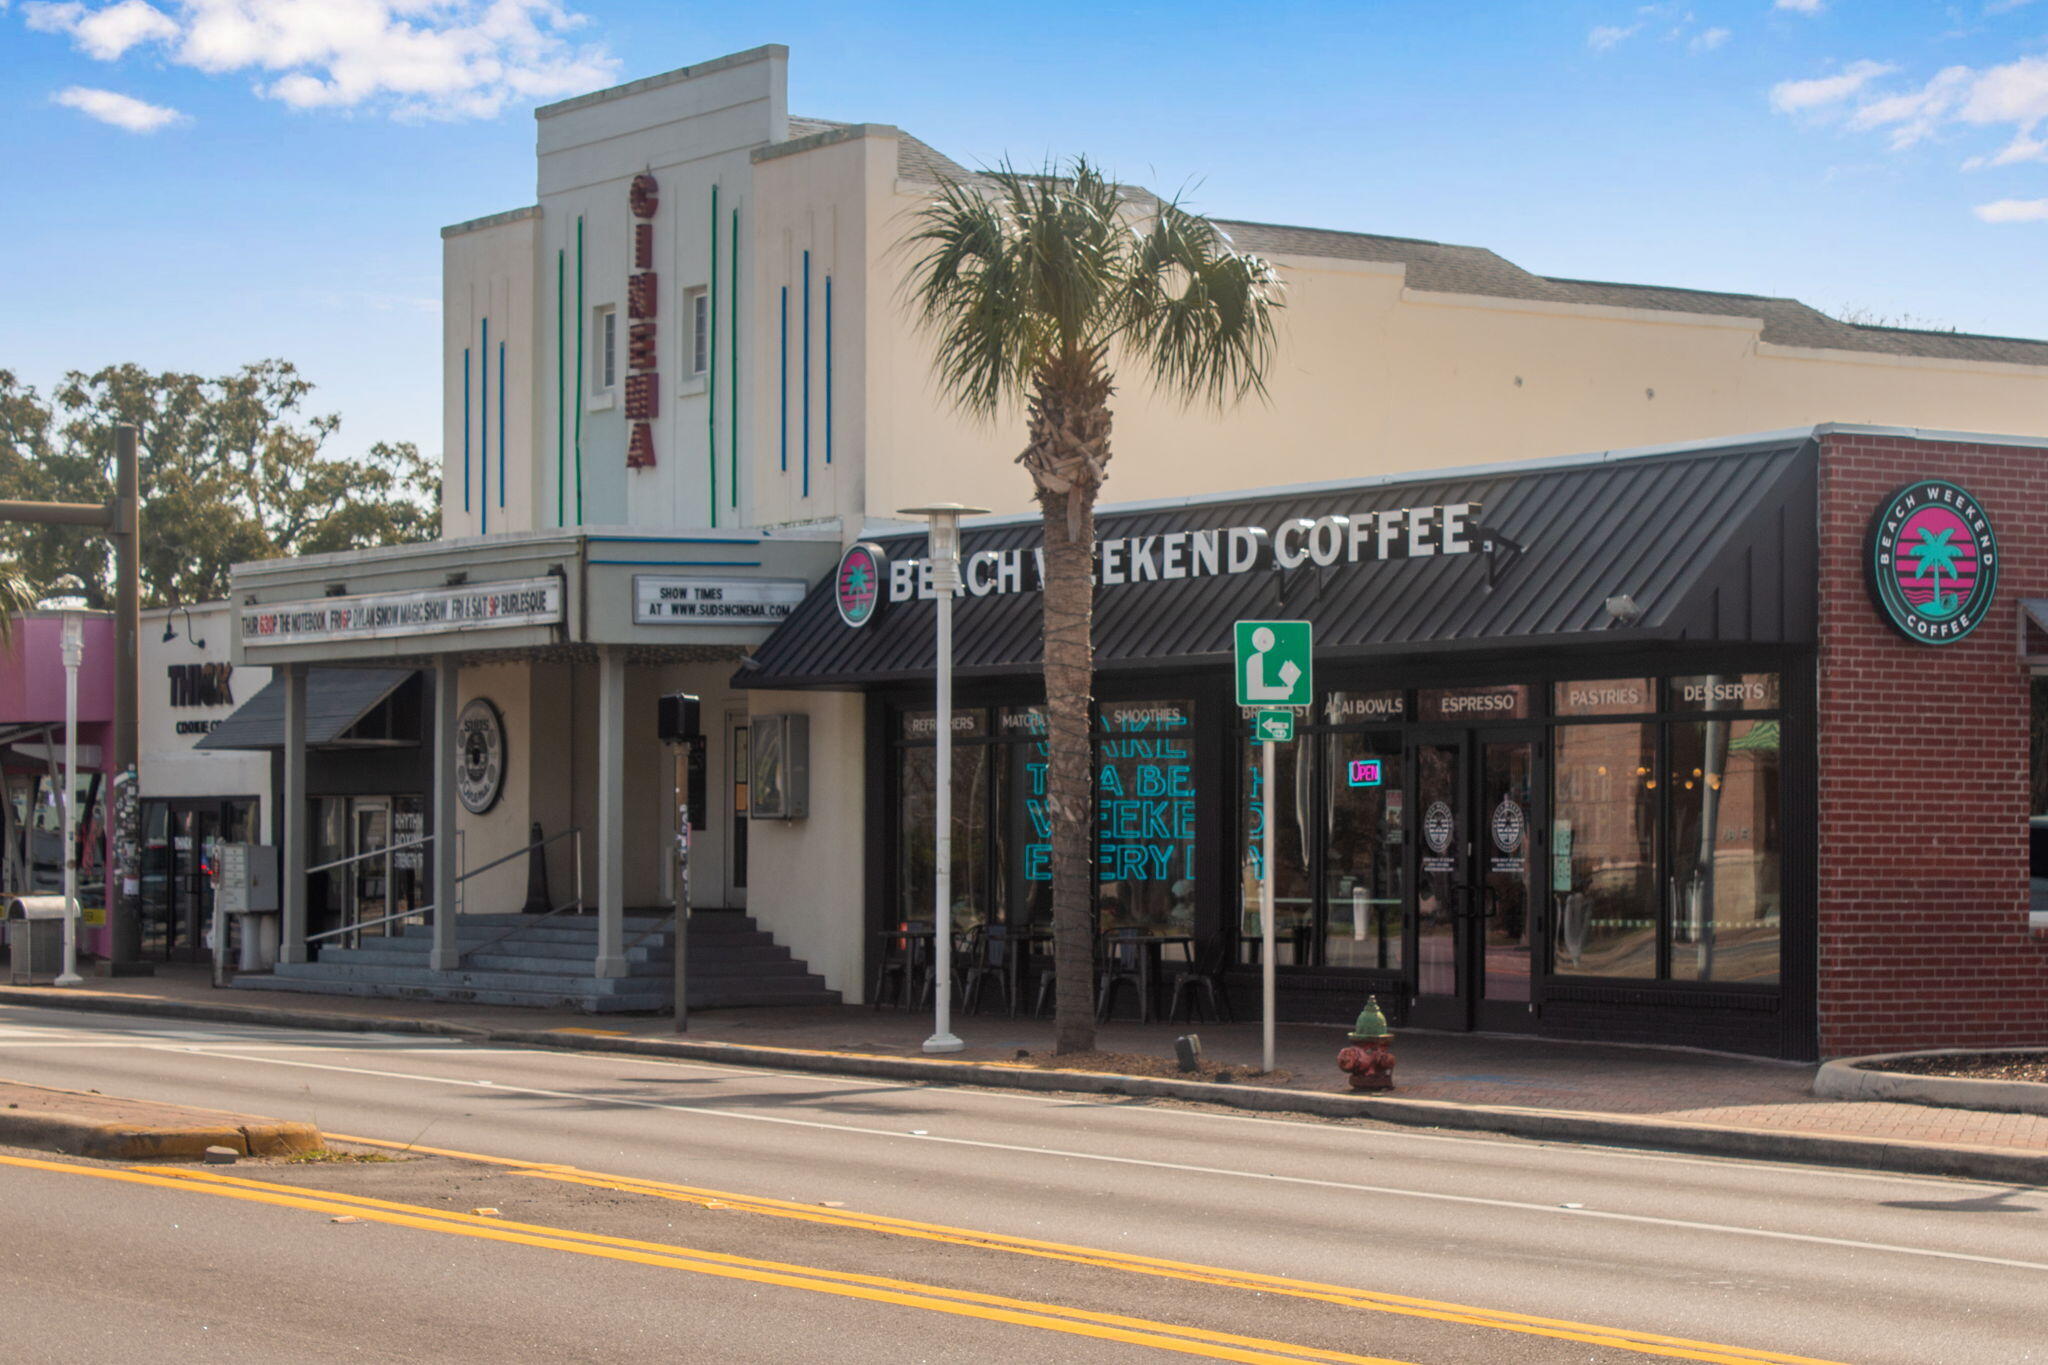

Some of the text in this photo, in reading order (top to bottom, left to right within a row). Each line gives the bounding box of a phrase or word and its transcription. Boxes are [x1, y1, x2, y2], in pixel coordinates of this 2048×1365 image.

[625, 175, 659, 469] CINEMA
[1880, 487, 1993, 565] BEACH WEEKEND
[1274, 503, 1470, 569] COFFEE
[501, 590, 546, 613] BURLESQUE
[660, 588, 723, 600] SHOW TIMES
[650, 603, 790, 616] AT WWW.SUDSNCINEMA.COM
[1907, 614, 1970, 637] COFFEE
[1570, 688, 1639, 707] PASTRIES
[1684, 683, 1765, 702] DESSERTS
[1356, 698, 1404, 714] BOWLS
[1441, 694, 1515, 713] ESPRESSO
[1002, 714, 1046, 728] MATCHA
[1114, 708, 1181, 724] SMOOTHIES
